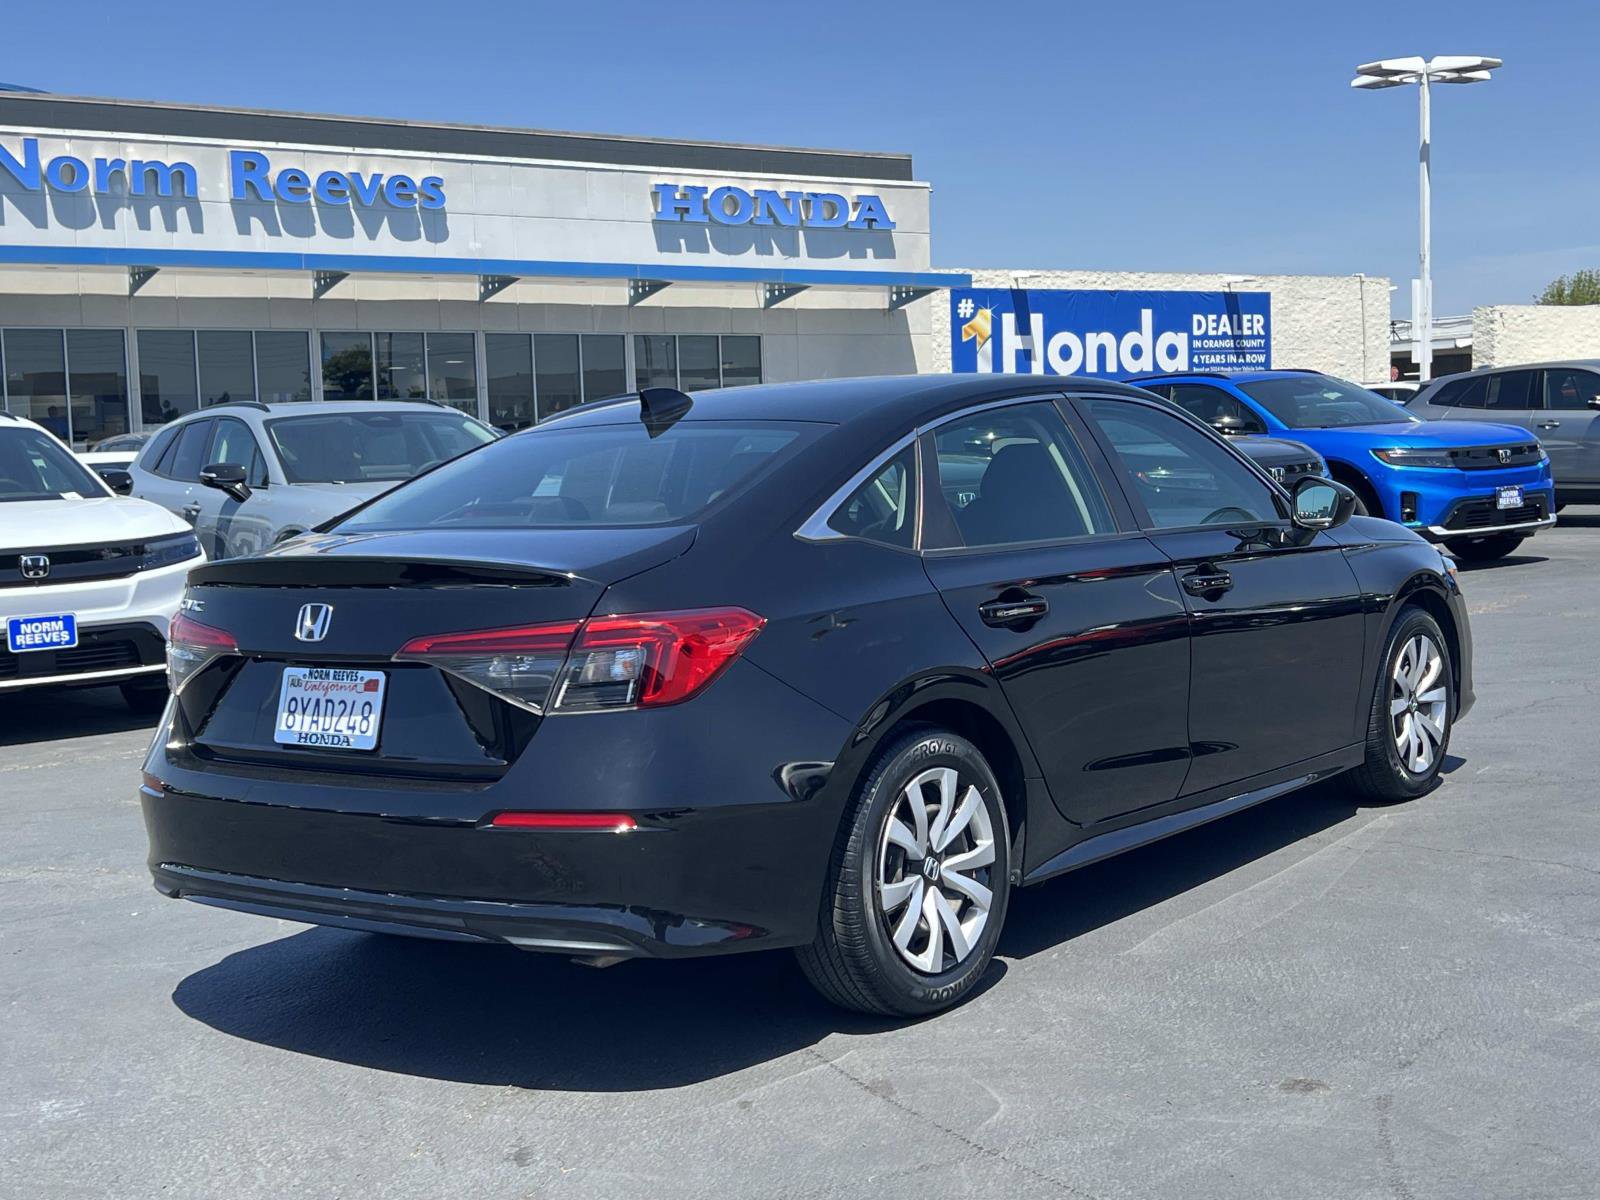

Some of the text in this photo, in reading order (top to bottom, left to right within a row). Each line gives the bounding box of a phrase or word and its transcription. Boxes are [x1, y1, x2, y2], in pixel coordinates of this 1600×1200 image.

[0, 137, 446, 209] Norm Reeves
[653, 183, 897, 229] HONDA
[1192, 314, 1266, 336] DEALER
[1002, 308, 1189, 376] Honda
[1192, 339, 1266, 349] IN ORANGE COUNTY
[1192, 353, 1266, 364] 4 YEARS IN A ROW
[20, 620, 64, 634] NORM
[16, 631, 70, 645] REEVES
[308, 669, 359, 682] NORM REEVES
[303, 681, 358, 697] California
[285, 697, 373, 734] 8YAD248
[297, 732, 352, 747] HONDA
